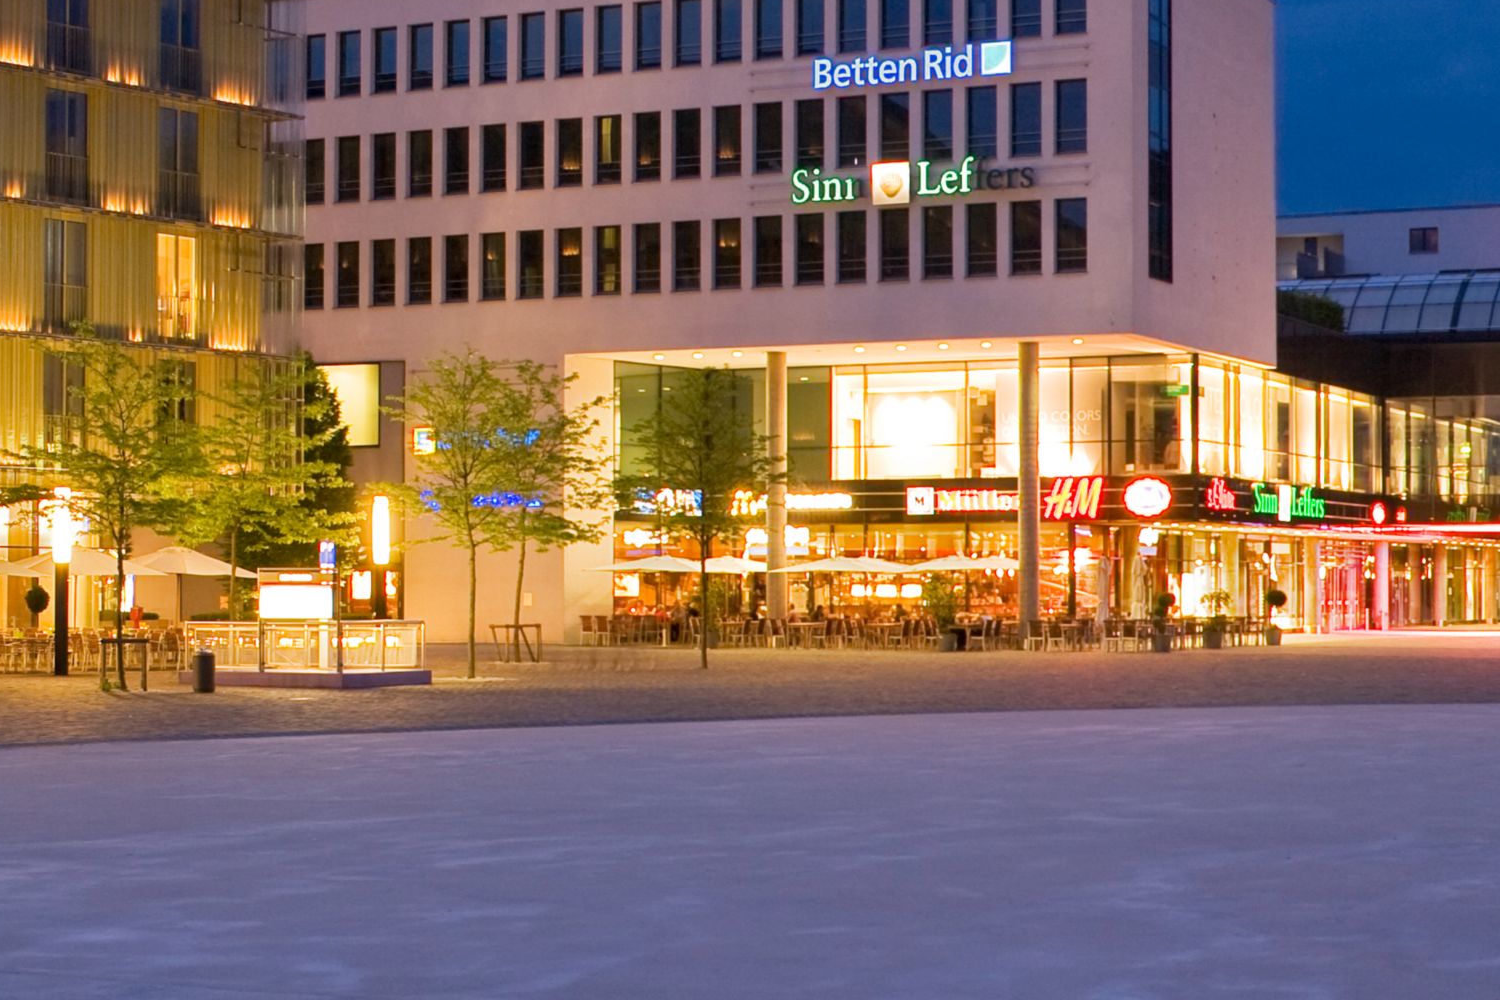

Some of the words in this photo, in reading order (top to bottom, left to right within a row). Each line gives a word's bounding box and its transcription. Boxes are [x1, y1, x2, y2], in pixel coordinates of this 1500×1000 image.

[813, 58, 917, 89] Betten
[923, 44, 973, 79] Rid
[1043, 476, 1103, 519] H&M
